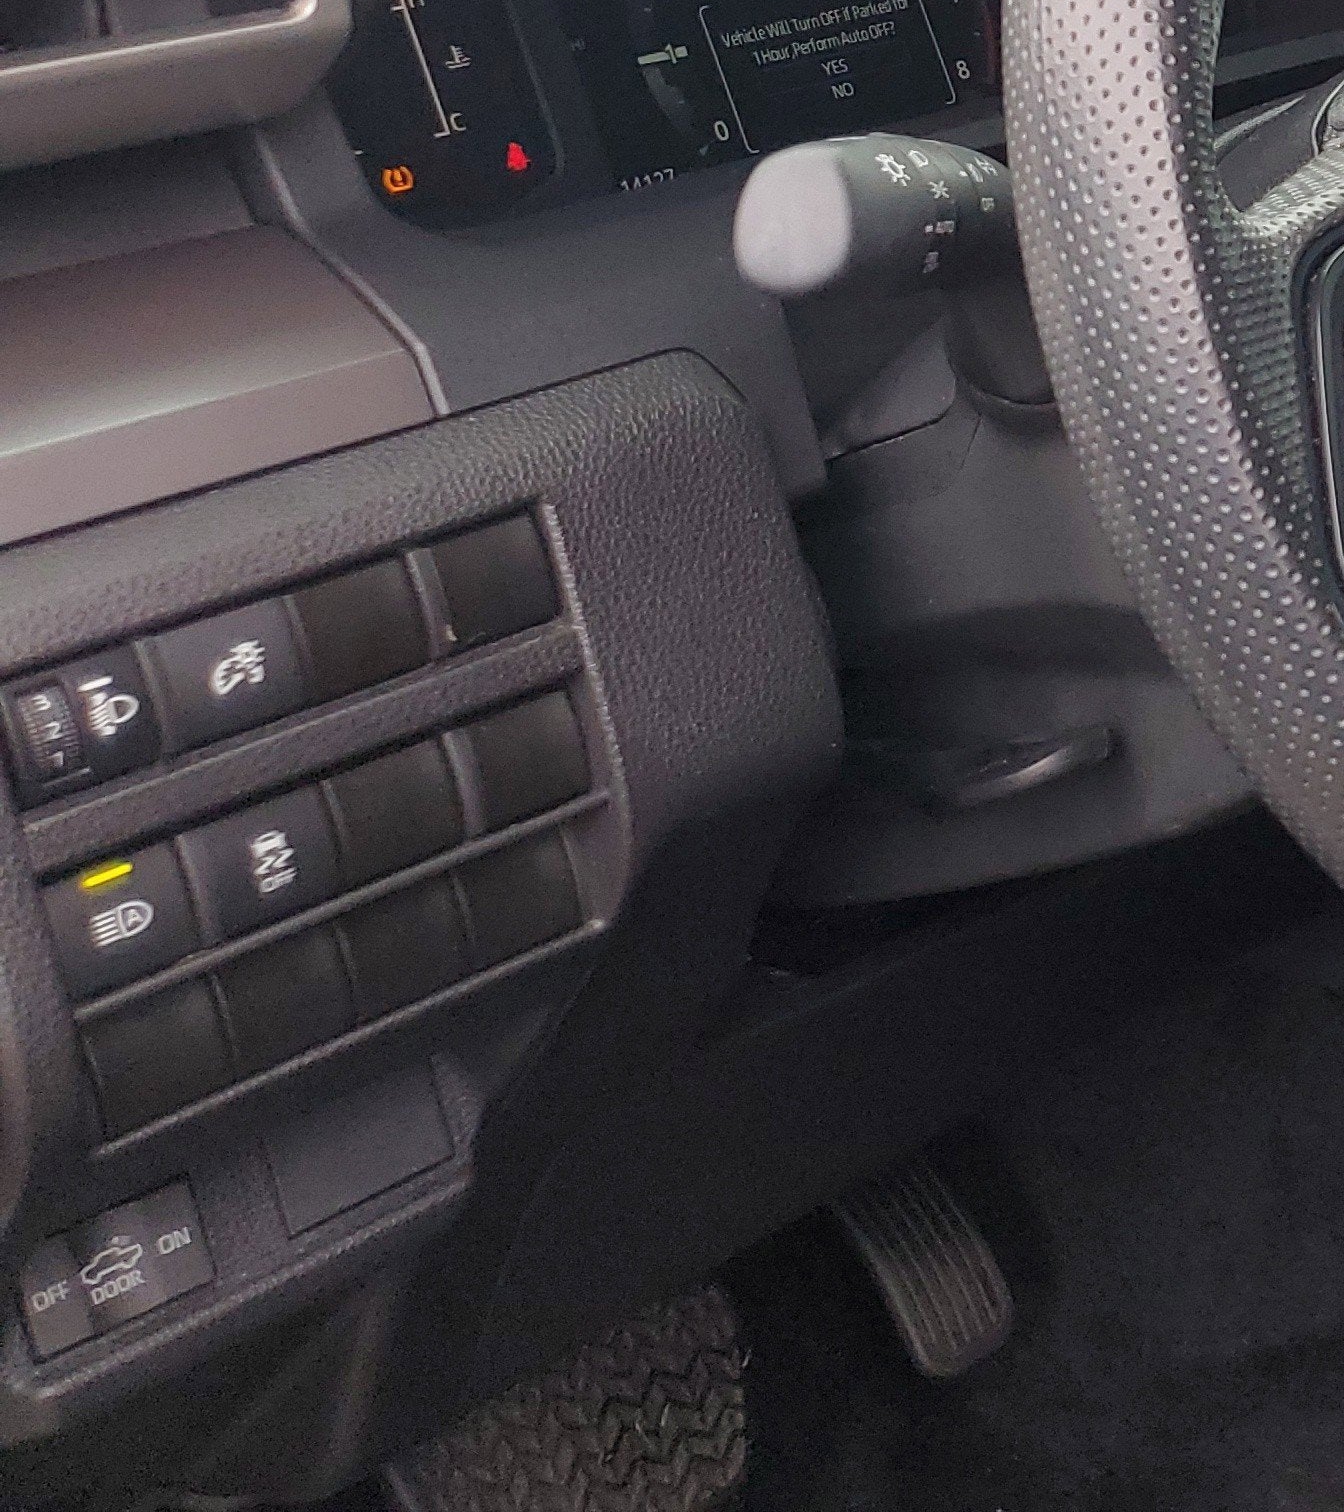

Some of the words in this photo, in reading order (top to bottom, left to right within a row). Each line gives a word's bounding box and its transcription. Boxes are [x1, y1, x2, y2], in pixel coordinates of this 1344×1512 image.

[721, 25, 766, 49] Vehicle
[764, 18, 793, 39] Will
[793, 16, 820, 32] Turn
[819, 10, 842, 27] OFF
[852, 0, 892, 20] Parked
[841, 30, 869, 47] Auto
[868, 20, 896, 39] OFF?
[664, 42, 677, 64] 1
[821, 58, 849, 77] YES
[956, 60, 971, 80] 8
[831, 82, 855, 101] NO
[450, 111, 467, 132] C
[713, 120, 730, 142] 0
[157, 1227, 192, 1256] ON
[32, 1280, 70, 1313] OFF
[90, 1269, 147, 1306] DOOR
